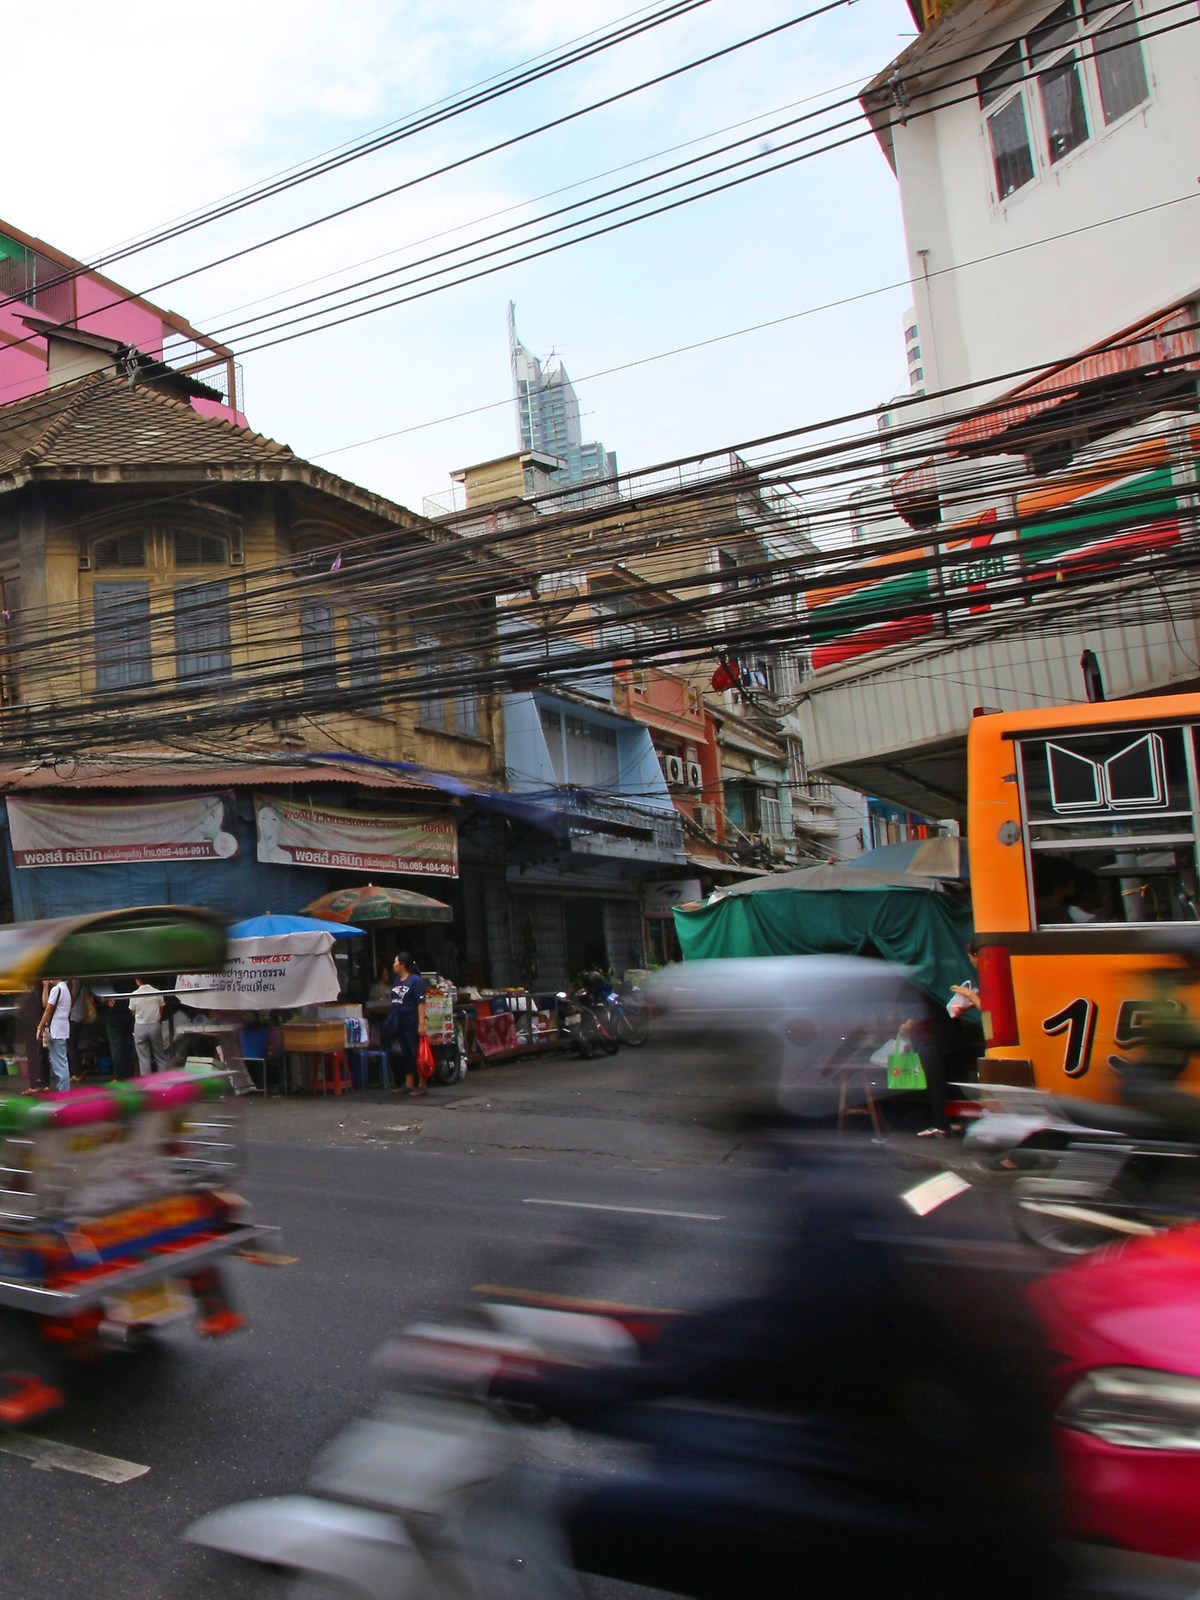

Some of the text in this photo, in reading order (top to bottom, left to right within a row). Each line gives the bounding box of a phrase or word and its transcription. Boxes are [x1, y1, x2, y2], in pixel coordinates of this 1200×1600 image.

[66, 848, 102, 862] คลินิก
[331, 853, 363, 868] คลินิก
